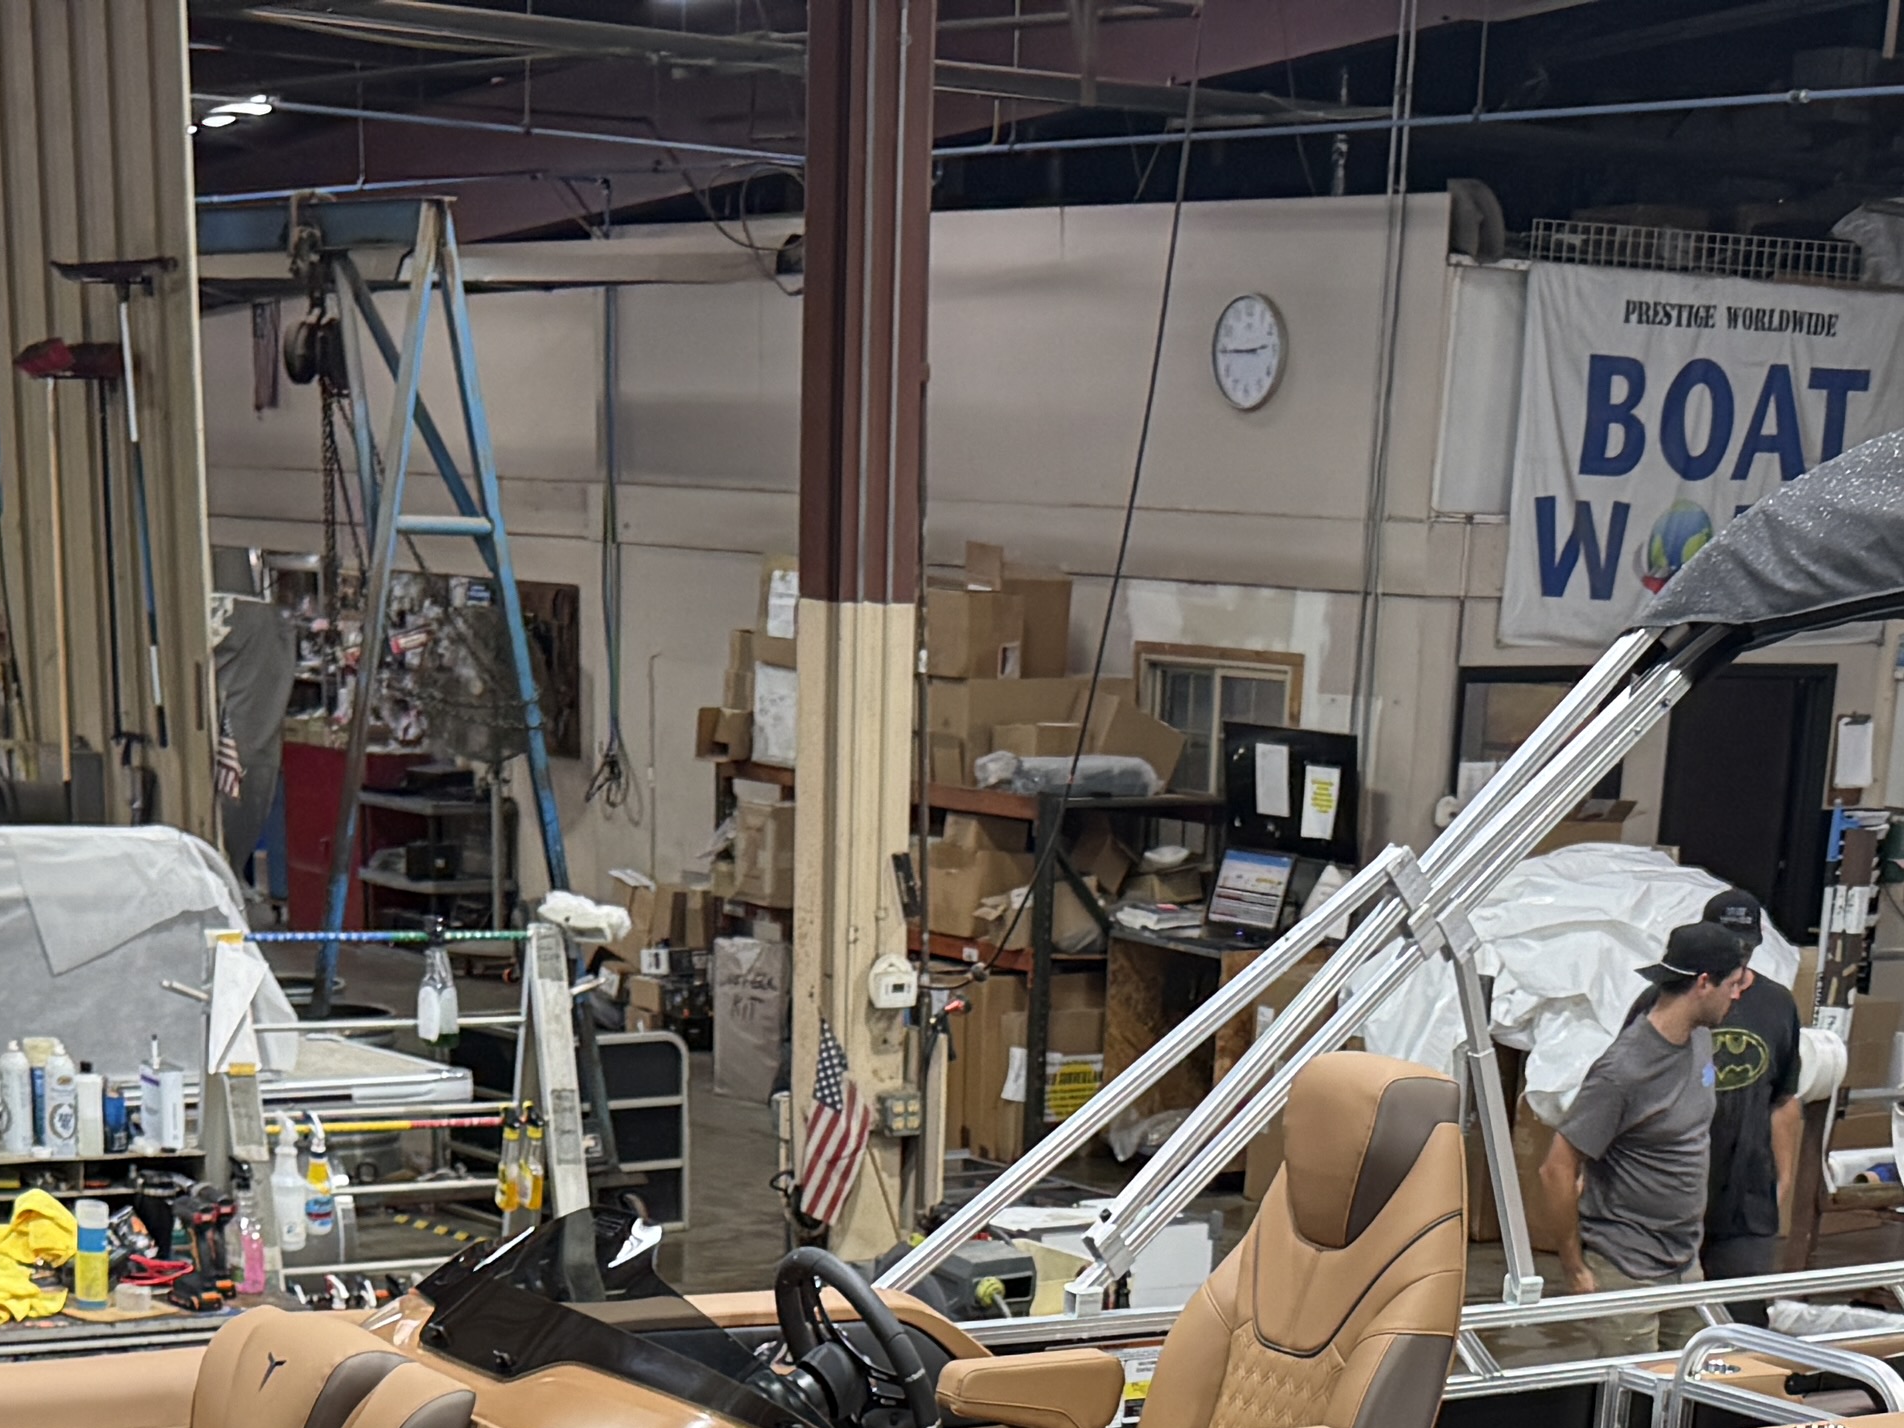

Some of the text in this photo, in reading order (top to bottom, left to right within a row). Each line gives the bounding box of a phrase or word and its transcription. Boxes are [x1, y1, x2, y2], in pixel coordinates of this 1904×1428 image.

[1623, 299, 1839, 338] PRESTIGE WORLDWIDE
[1579, 354, 1871, 482] BOAT
